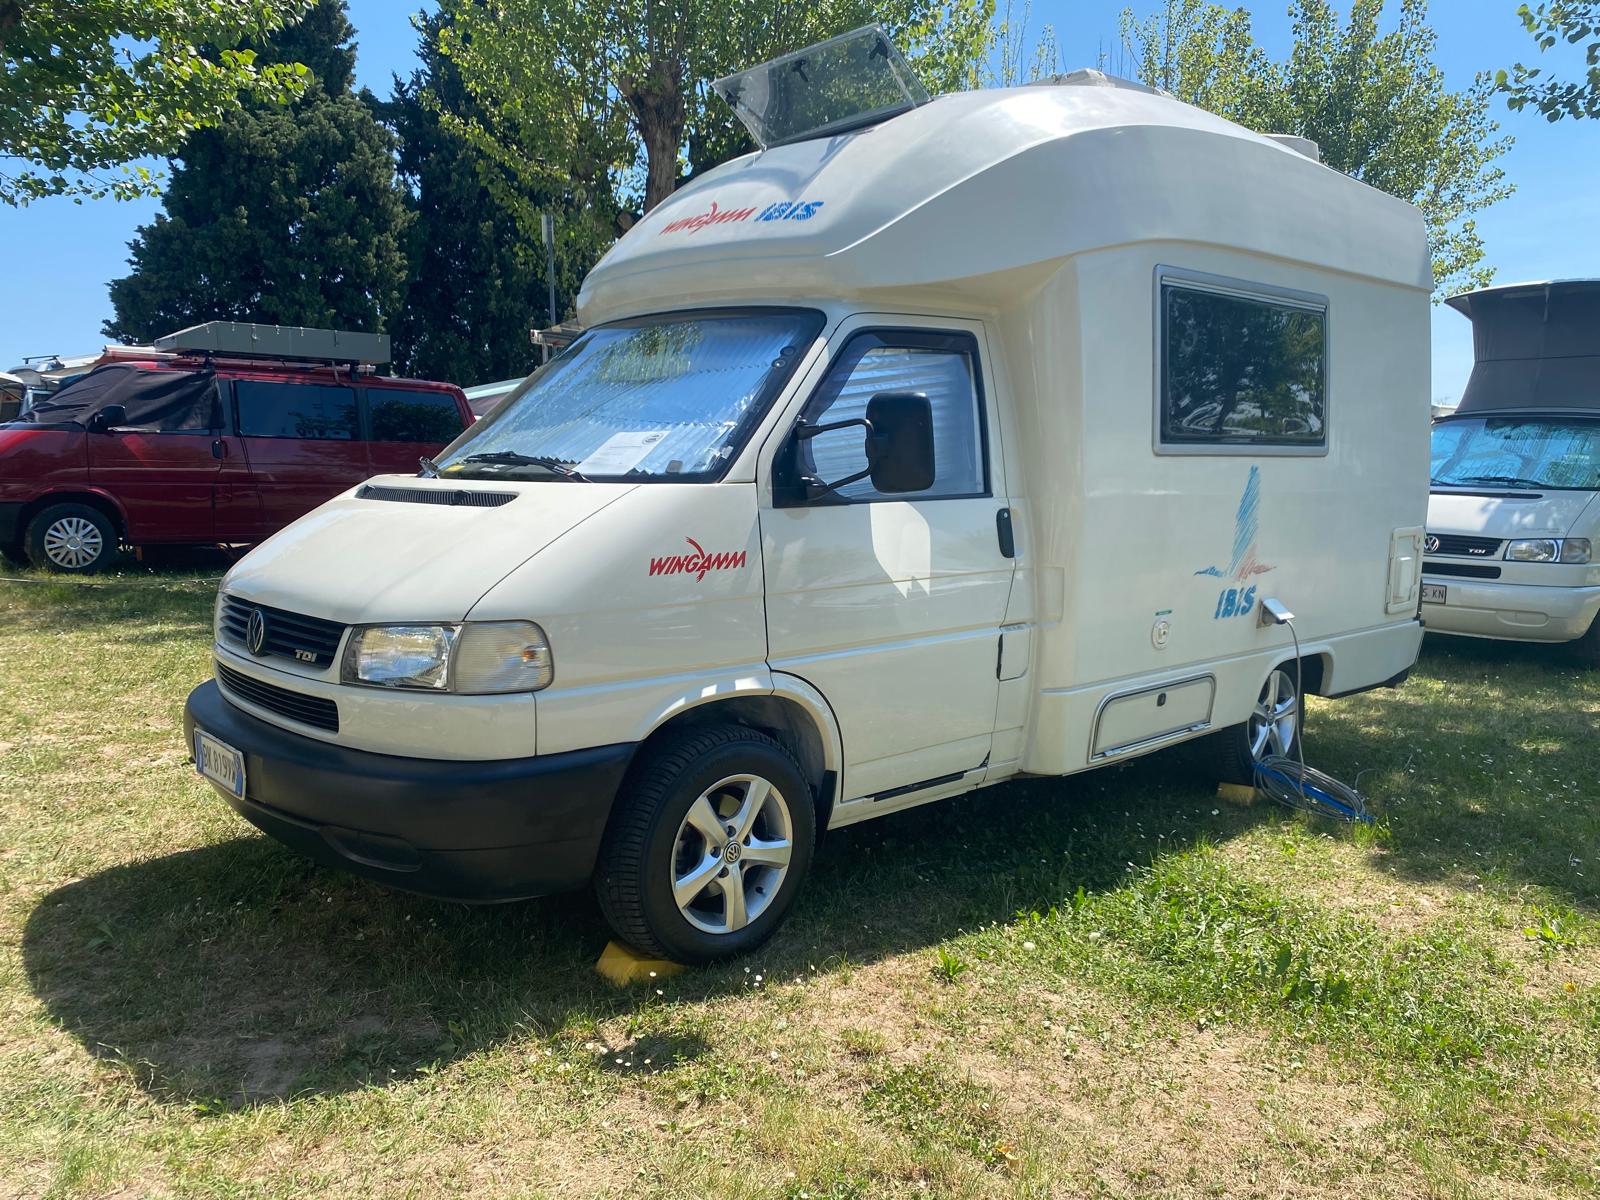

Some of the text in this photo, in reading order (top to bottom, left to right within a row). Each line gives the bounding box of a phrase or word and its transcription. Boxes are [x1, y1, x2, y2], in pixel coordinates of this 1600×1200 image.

[754, 201, 825, 222] IBIS
[649, 542, 746, 581] WINGAMM
[1214, 584, 1257, 620] IBIS
[1432, 589, 1444, 599] KN
[294, 648, 318, 663] TDI
